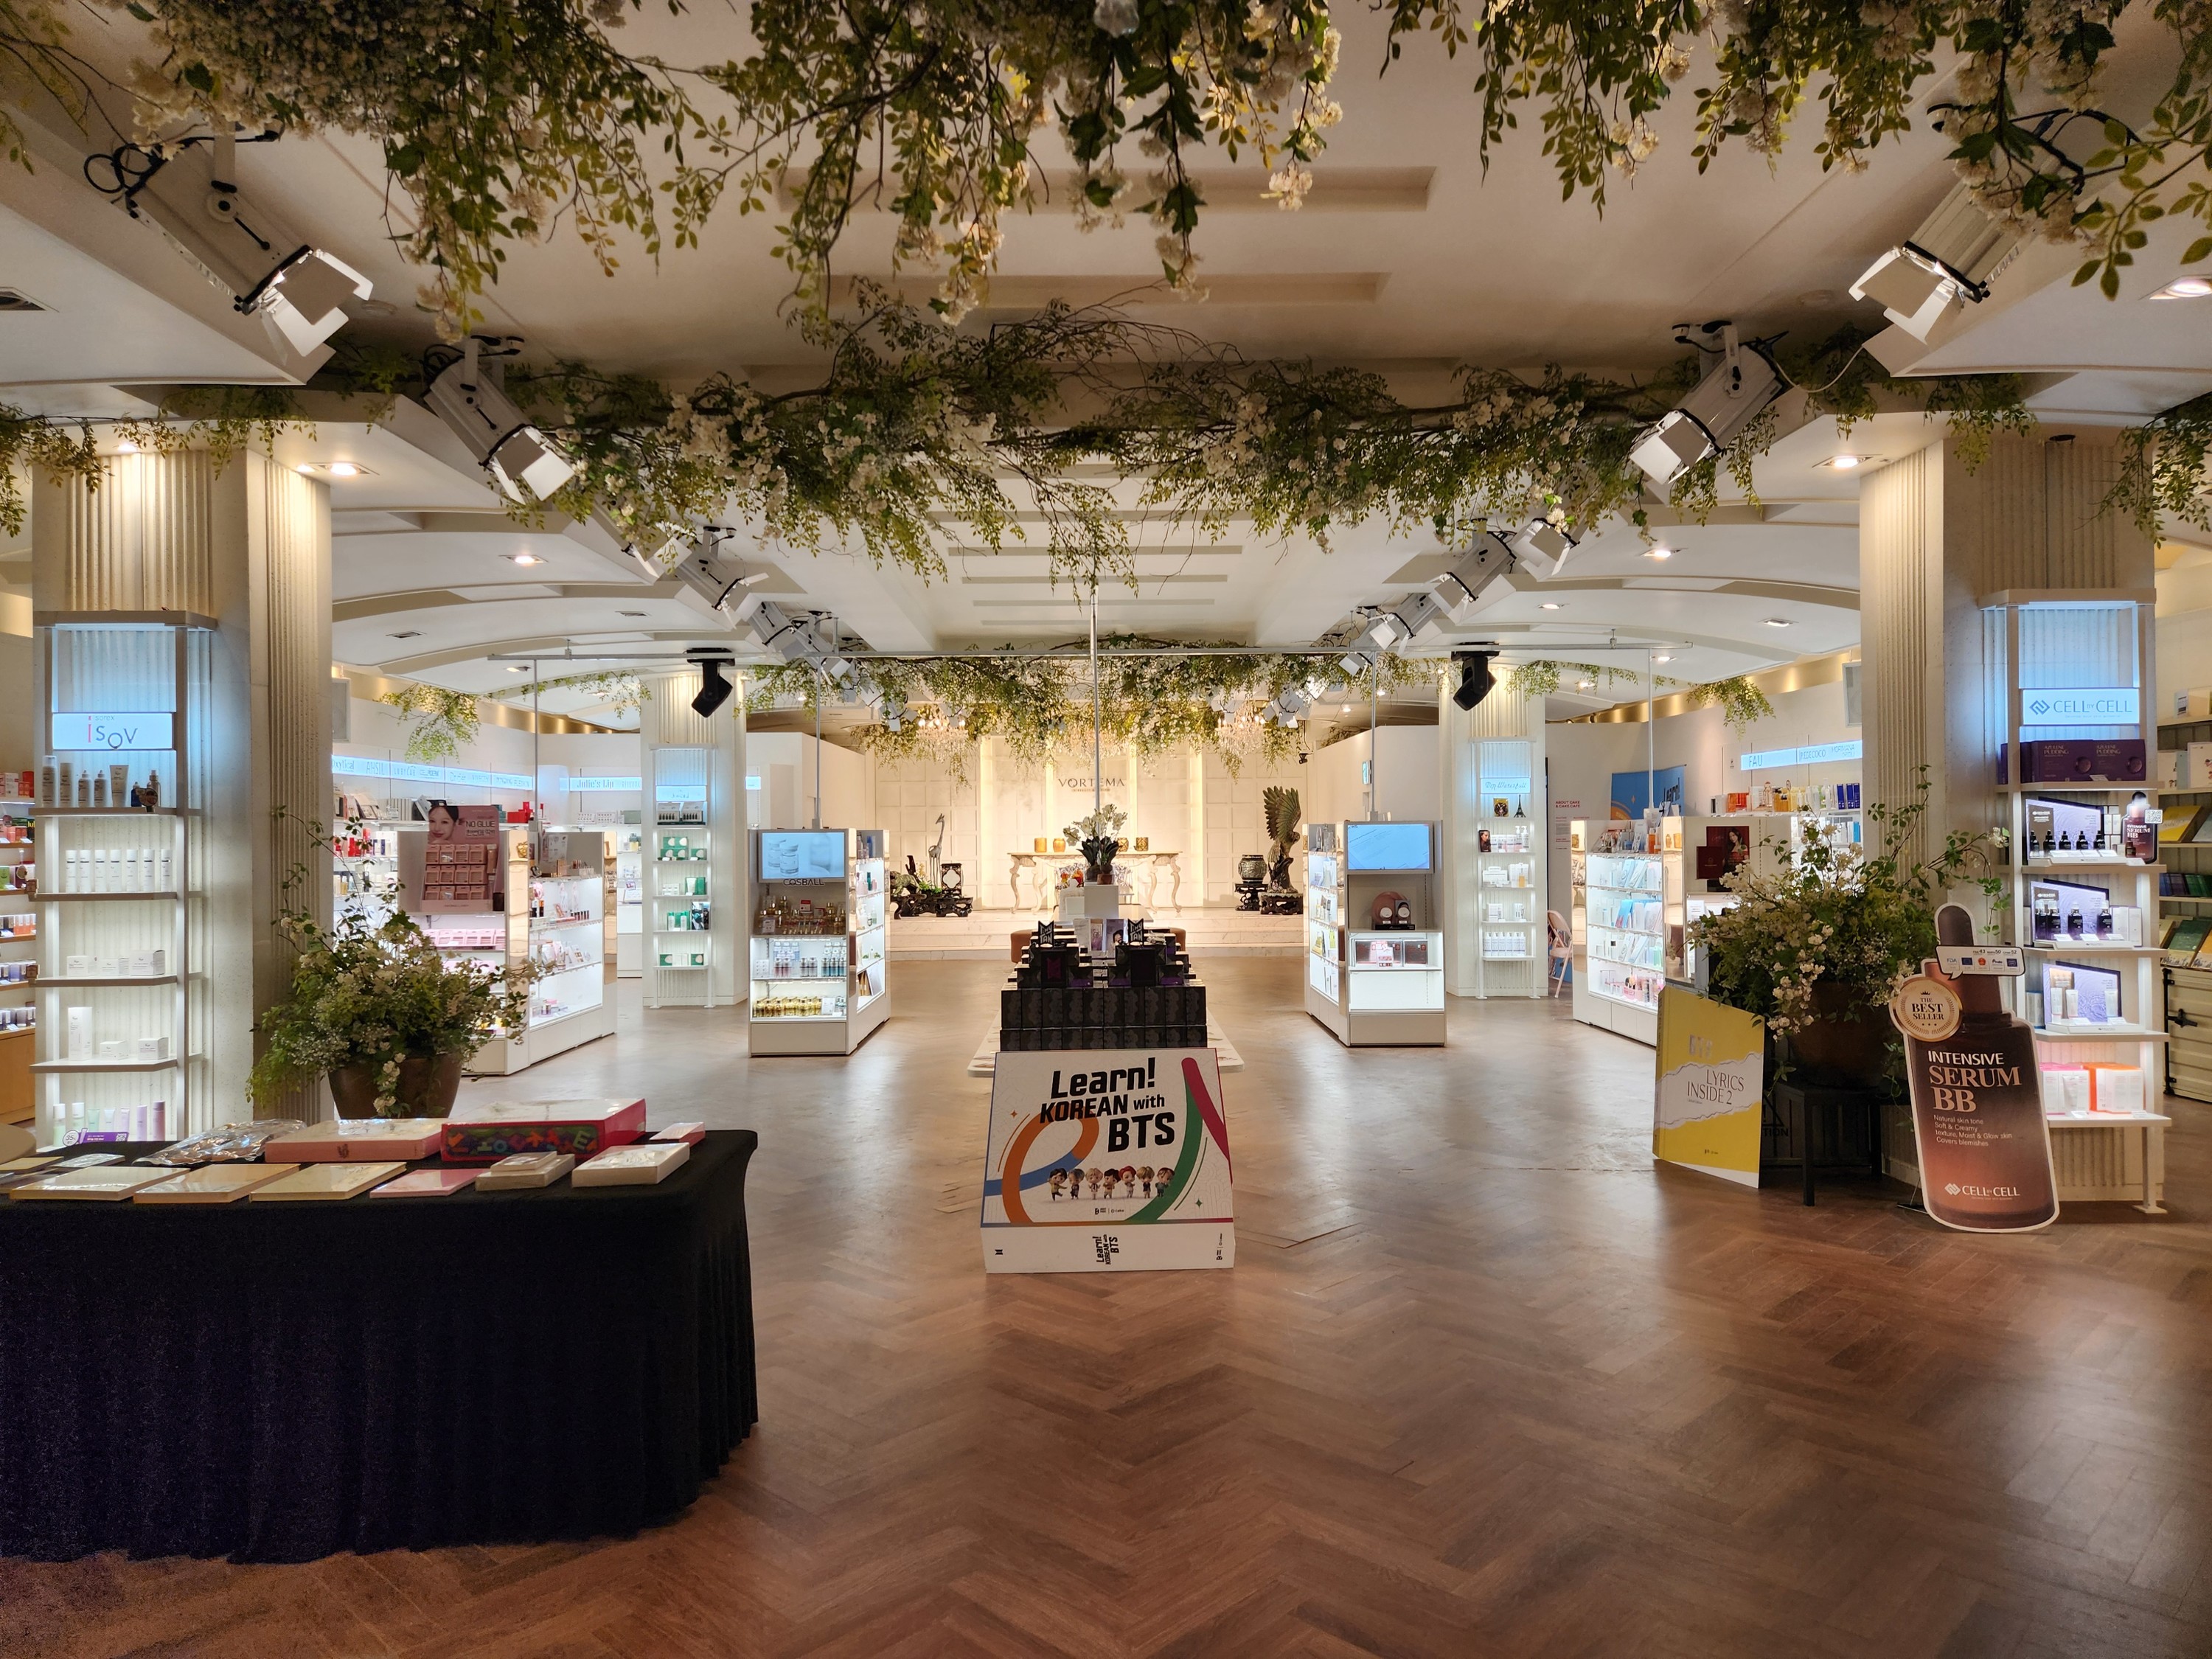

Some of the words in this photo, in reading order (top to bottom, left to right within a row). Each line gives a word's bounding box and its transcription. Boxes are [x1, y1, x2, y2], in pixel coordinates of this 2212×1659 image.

[2053, 700, 2089, 713] CELL
[2096, 700, 2132, 713] CELL
[1749, 754, 1763, 768] FAU
[577, 779, 601, 788] Julie's
[603, 779, 614, 789] Lip
[1058, 778, 1124, 788] VORTEMA
[1040, 932, 1052, 944] TAN
[1130, 931, 1143, 942] TAN
[1911, 1004, 1943, 1013] BEST
[1928, 1050, 2004, 1065] INTENSIVE
[1051, 1057, 1155, 1099] Learn!
[1706, 1069, 1744, 1091] LYRICS
[1929, 1065, 2023, 1088] SERUM
[1687, 1081, 1724, 1103] INSIDE
[1726, 1091, 1732, 1105] 2
[1930, 1086, 1976, 1113] BB
[1040, 1094, 1128, 1124] KOREAN
[1133, 1094, 1165, 1110] with
[1107, 1112, 1175, 1152] BTS
[1934, 1121, 1947, 1130] Soft
[1962, 1186, 1989, 1196] CELL
[1993, 1186, 2020, 1196] CELL
[1092, 1237, 1105, 1262] Learn!
[1109, 1237, 1119, 1253] BTS
